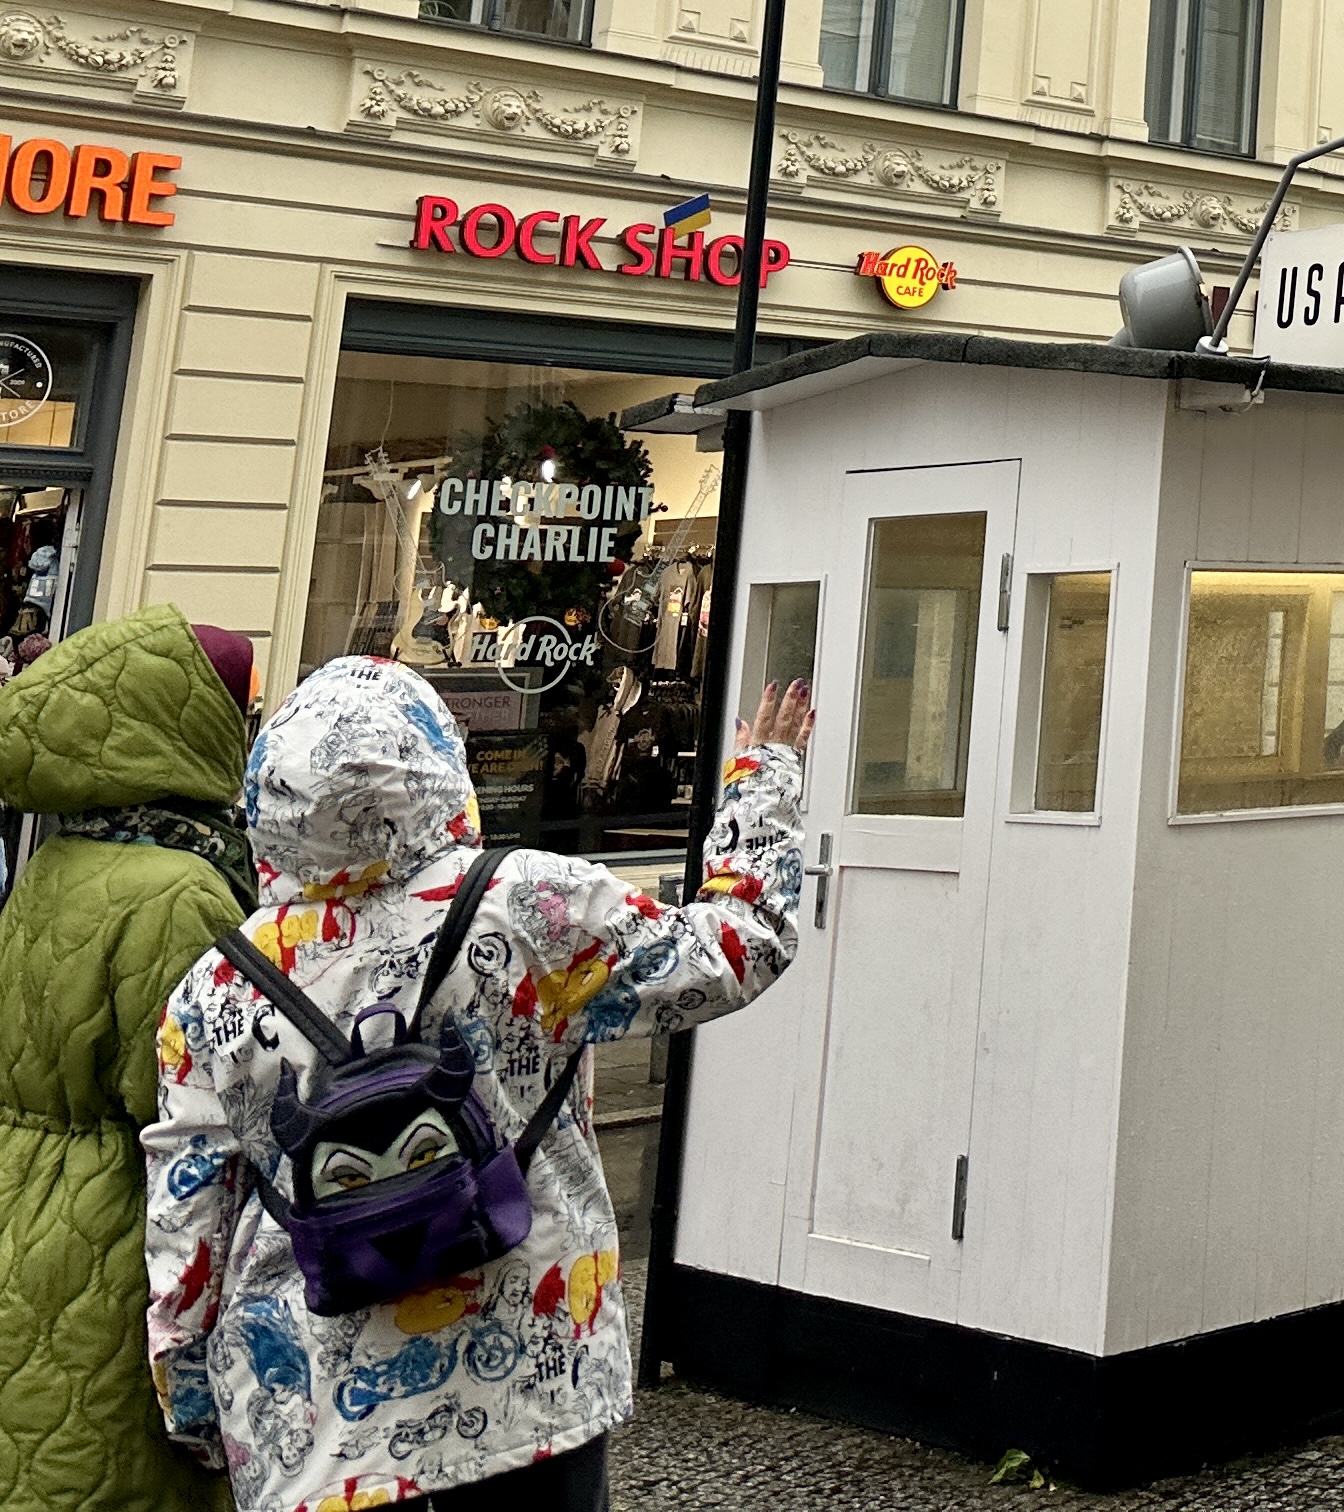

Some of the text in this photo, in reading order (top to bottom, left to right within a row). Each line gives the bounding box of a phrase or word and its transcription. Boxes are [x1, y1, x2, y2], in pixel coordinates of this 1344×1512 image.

[0, 134, 183, 228] ORE
[410, 194, 791, 289] ROCK SHOP
[857, 251, 957, 290] Hard Rock
[896, 285, 925, 298] CAFE
[438, 477, 656, 522] CHECKPOINT
[471, 522, 618, 563] CHARLIE
[535, 634, 598, 667] Rock
[476, 749, 513, 762] COME
[507, 1054, 541, 1077] THE
[536, 1354, 567, 1383] THE
